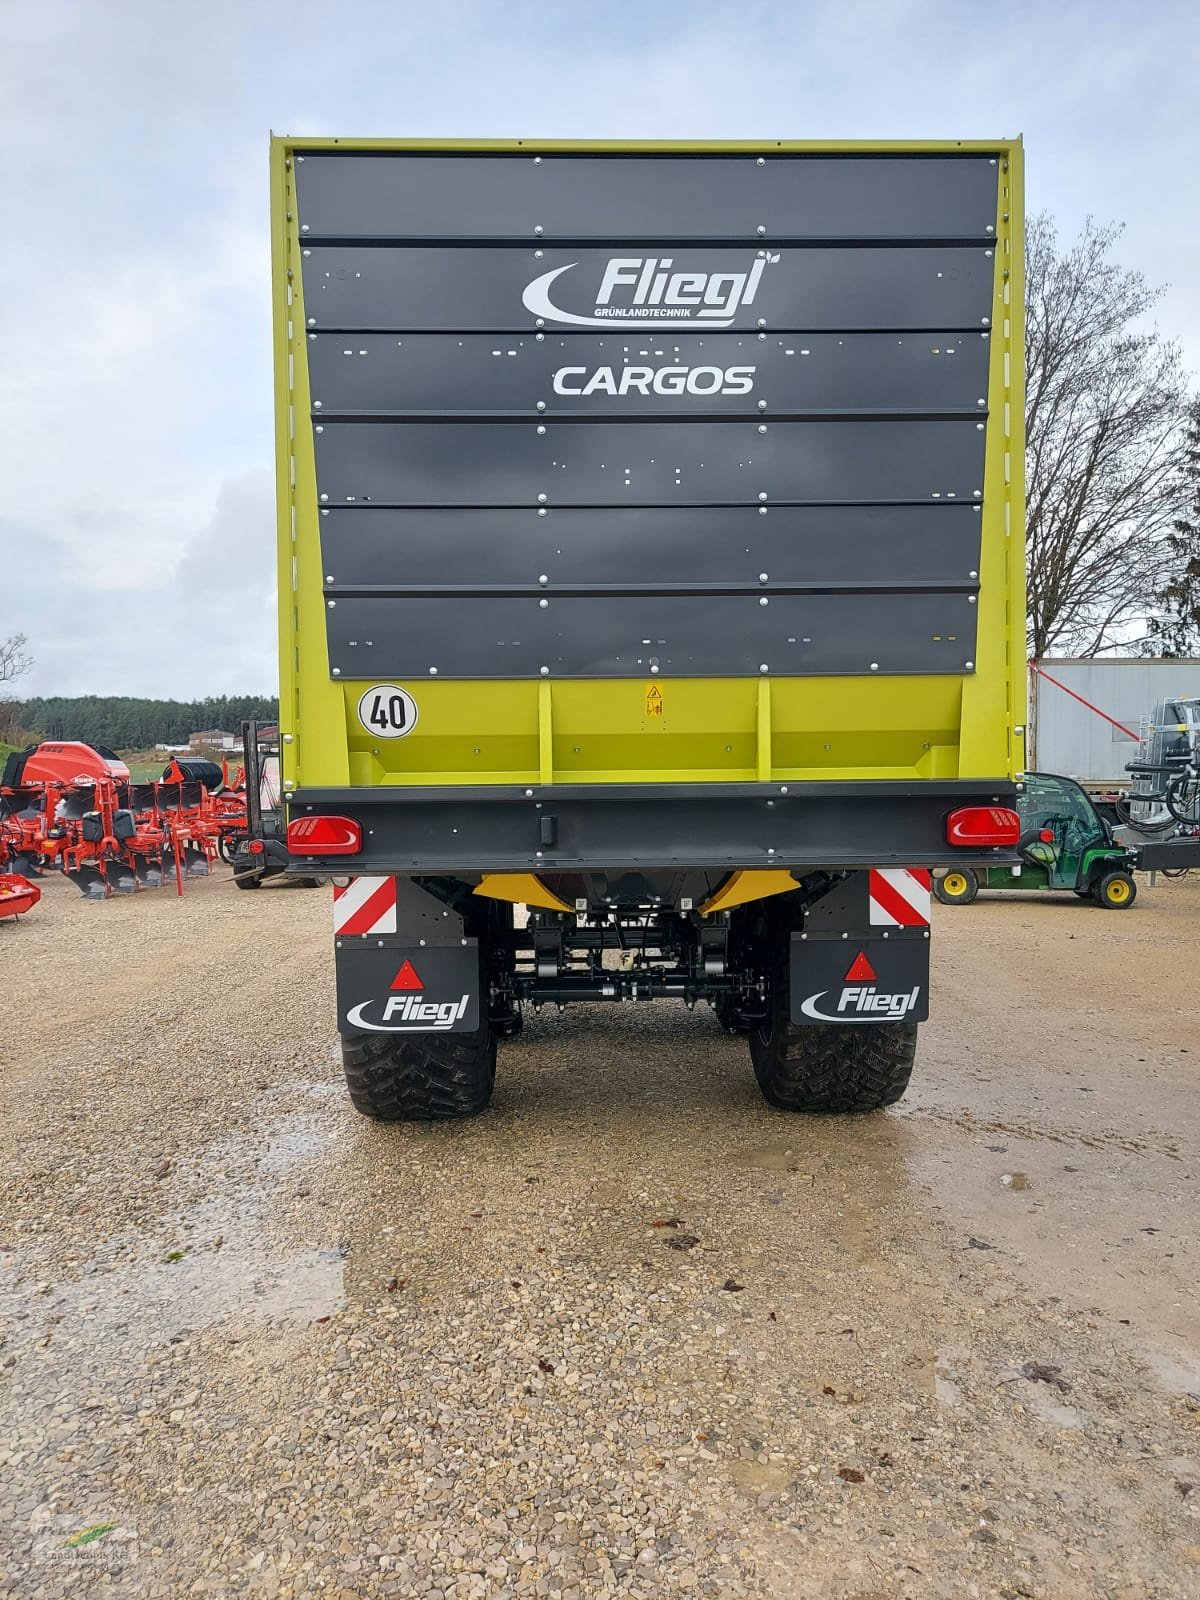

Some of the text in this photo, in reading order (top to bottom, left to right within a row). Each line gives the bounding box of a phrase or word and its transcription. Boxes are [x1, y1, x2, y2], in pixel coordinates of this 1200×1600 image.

[595, 258, 766, 317] Fliegl
[594, 306, 691, 317] GRÜNLANDTECHNIK
[553, 366, 756, 396] CARGOS
[370, 695, 406, 729] 40
[382, 995, 470, 1025] Fliegl
[837, 986, 920, 1016] Fliegl
